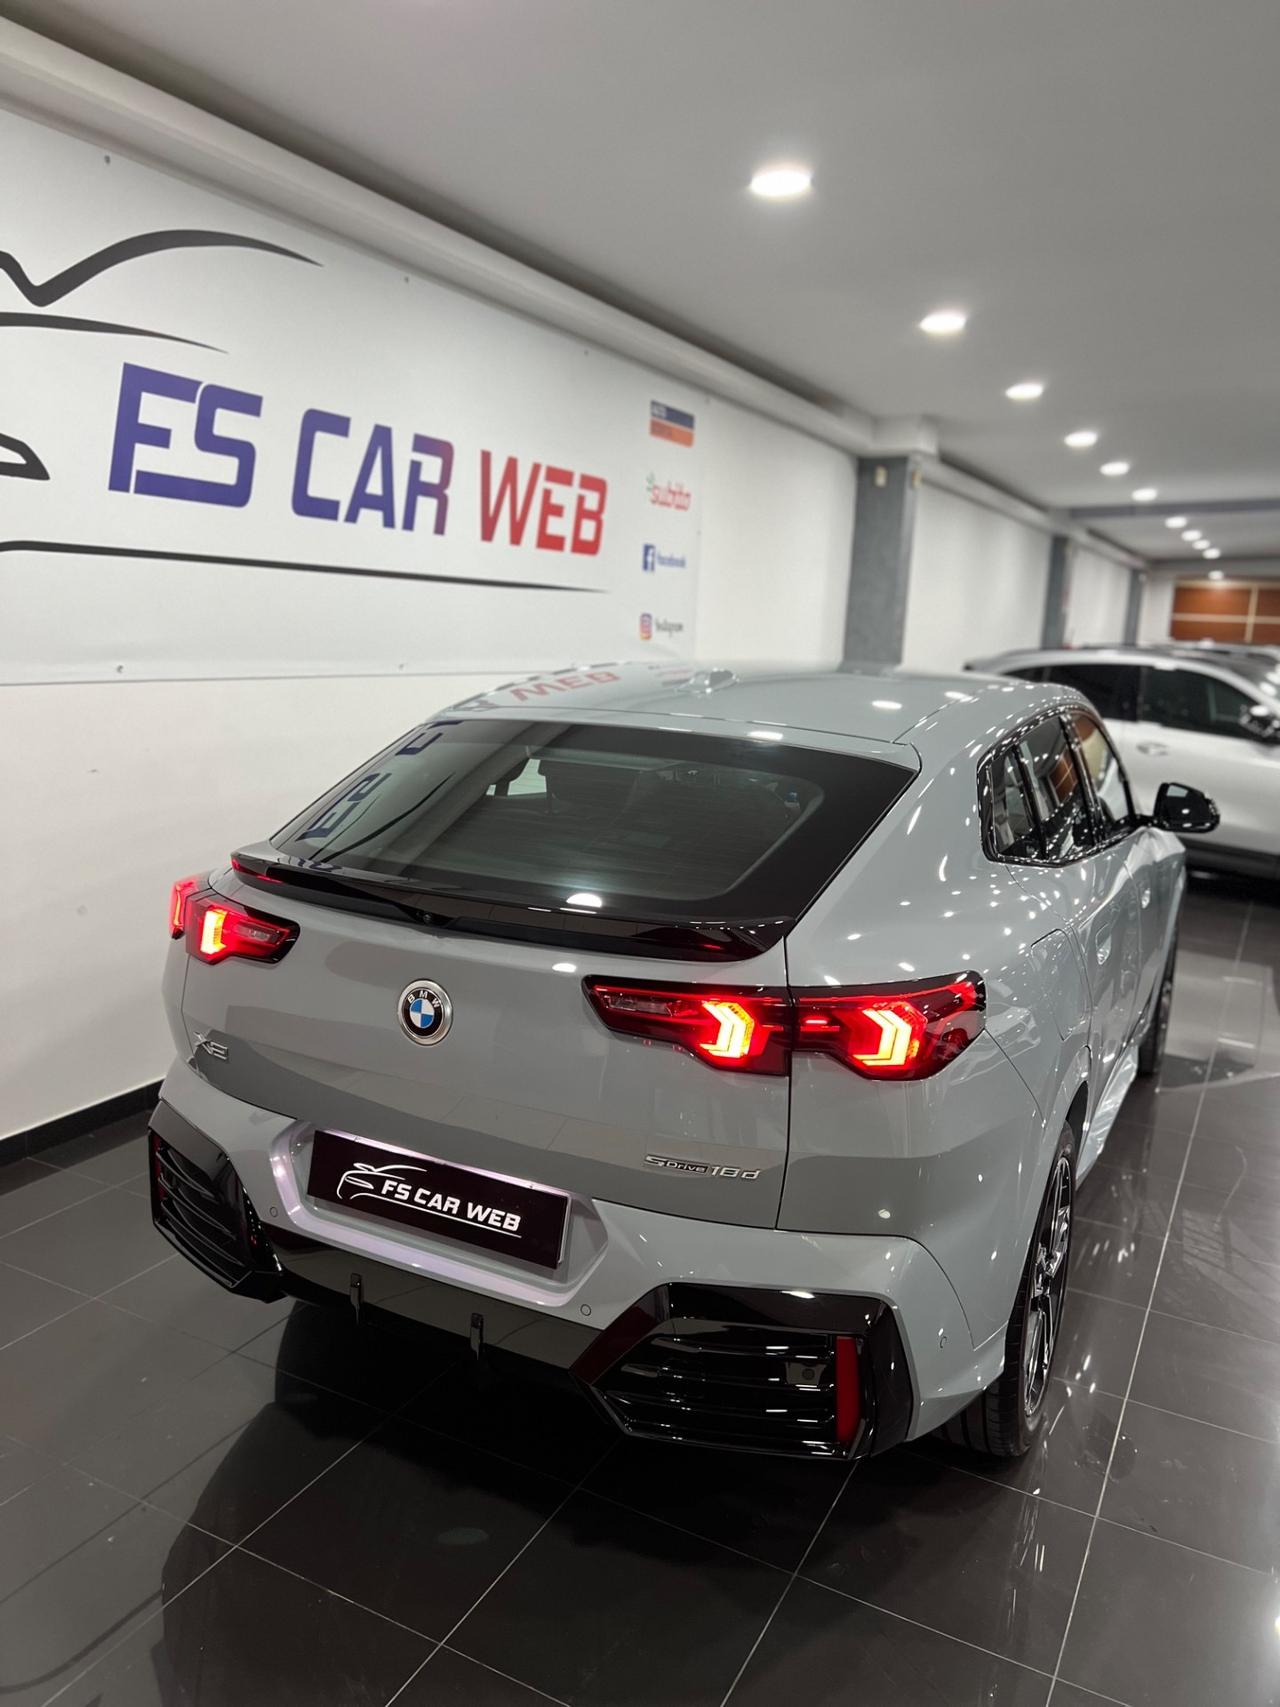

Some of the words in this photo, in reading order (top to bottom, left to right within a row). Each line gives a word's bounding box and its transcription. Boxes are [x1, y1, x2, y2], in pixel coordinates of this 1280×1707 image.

[108, 362, 263, 508] FS
[291, 408, 454, 536] CAR
[481, 449, 608, 557] WEB
[407, 990, 441, 1008] BMW
[194, 1031, 228, 1060] X2
[381, 1179, 411, 1201] FS
[413, 1187, 461, 1215] CAR
[467, 1202, 521, 1232] WEB
